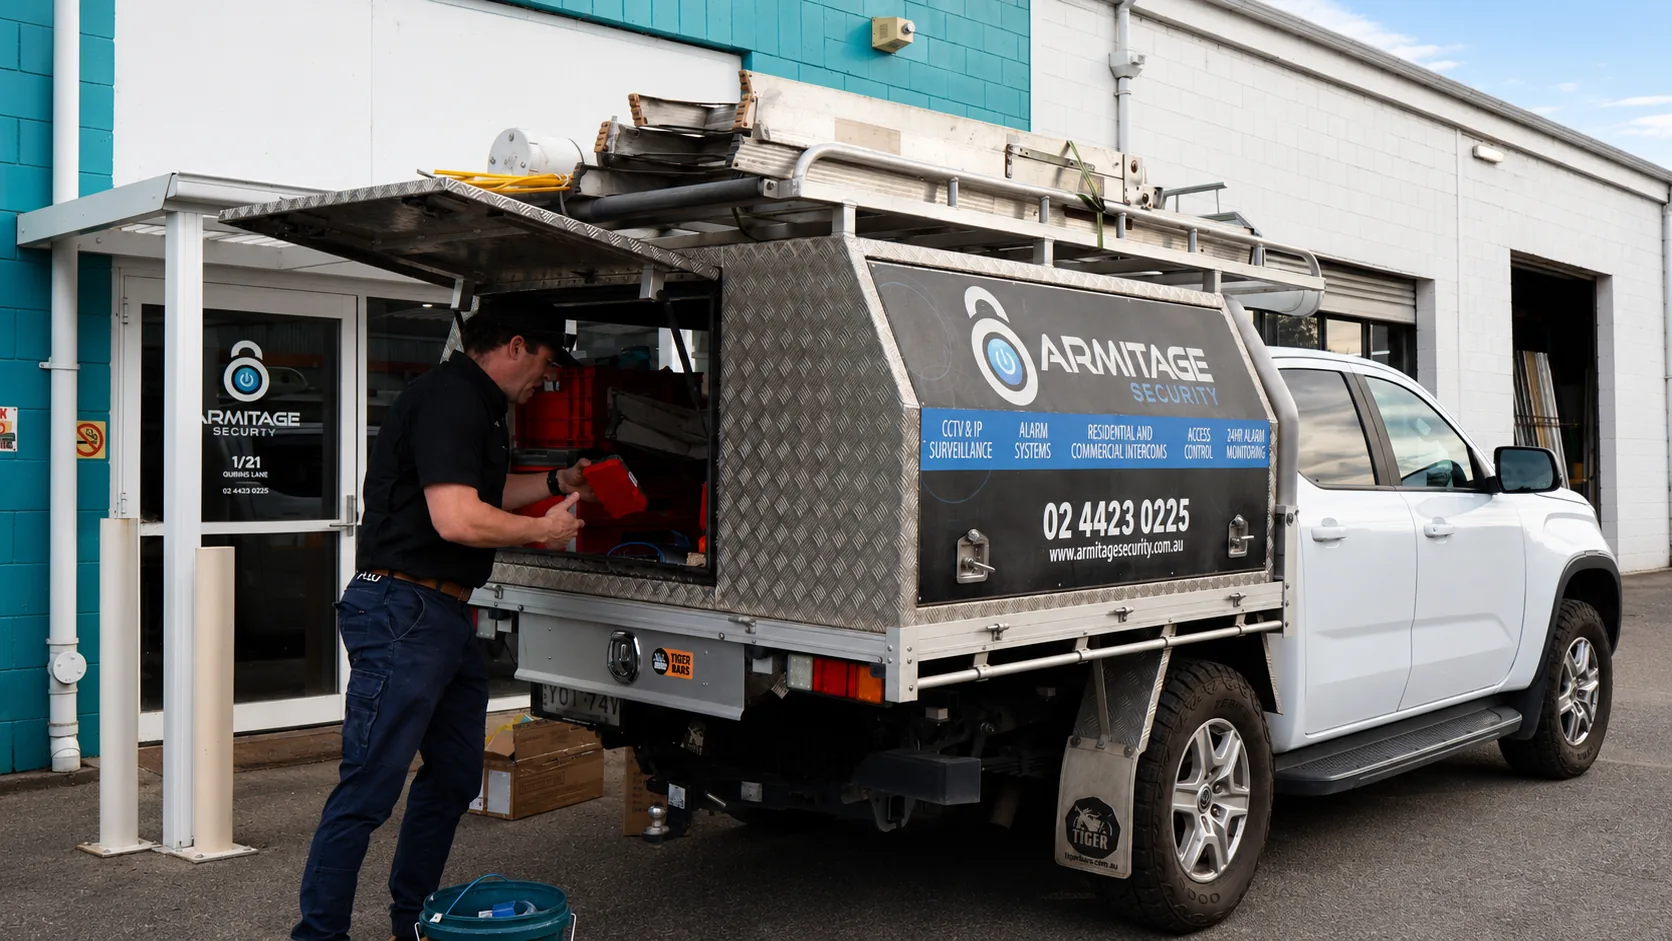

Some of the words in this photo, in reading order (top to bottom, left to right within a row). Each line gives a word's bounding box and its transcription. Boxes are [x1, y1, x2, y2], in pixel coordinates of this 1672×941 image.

[1041, 333, 1214, 383] ARMITAGE
[1130, 382, 1218, 406] SECURITY
[941, 419, 964, 437] CCTV
[965, 420, 972, 438] &
[973, 421, 983, 438] IP
[1019, 421, 1048, 439] ALARM
[1087, 424, 1135, 441] RESIDENTIAL
[1136, 425, 1153, 441] AND
[1187, 427, 1211, 442] ACCESS
[1243, 429, 1265, 443] ALARM
[929, 441, 992, 459] SURVEILLANCE
[1014, 442, 1051, 459] SYSTEMS
[1071, 443, 1124, 459] COMMERCIAL
[1125, 444, 1167, 459] INTERCOMS
[1184, 444, 1213, 460] CONTROL
[1226, 446, 1266, 460] MONITORING
[232, 456, 260, 469] 1/21
[1043, 502, 1072, 540] 02
[1078, 500, 1135, 537] 4423
[1140, 498, 1190, 534] 0225
[1049, 538, 1184, 562] www.armitagesecurity.com.au
[671, 653, 691, 666] TIGER
[671, 664, 690, 676] BARS
[1072, 828, 1108, 850] TIGER
